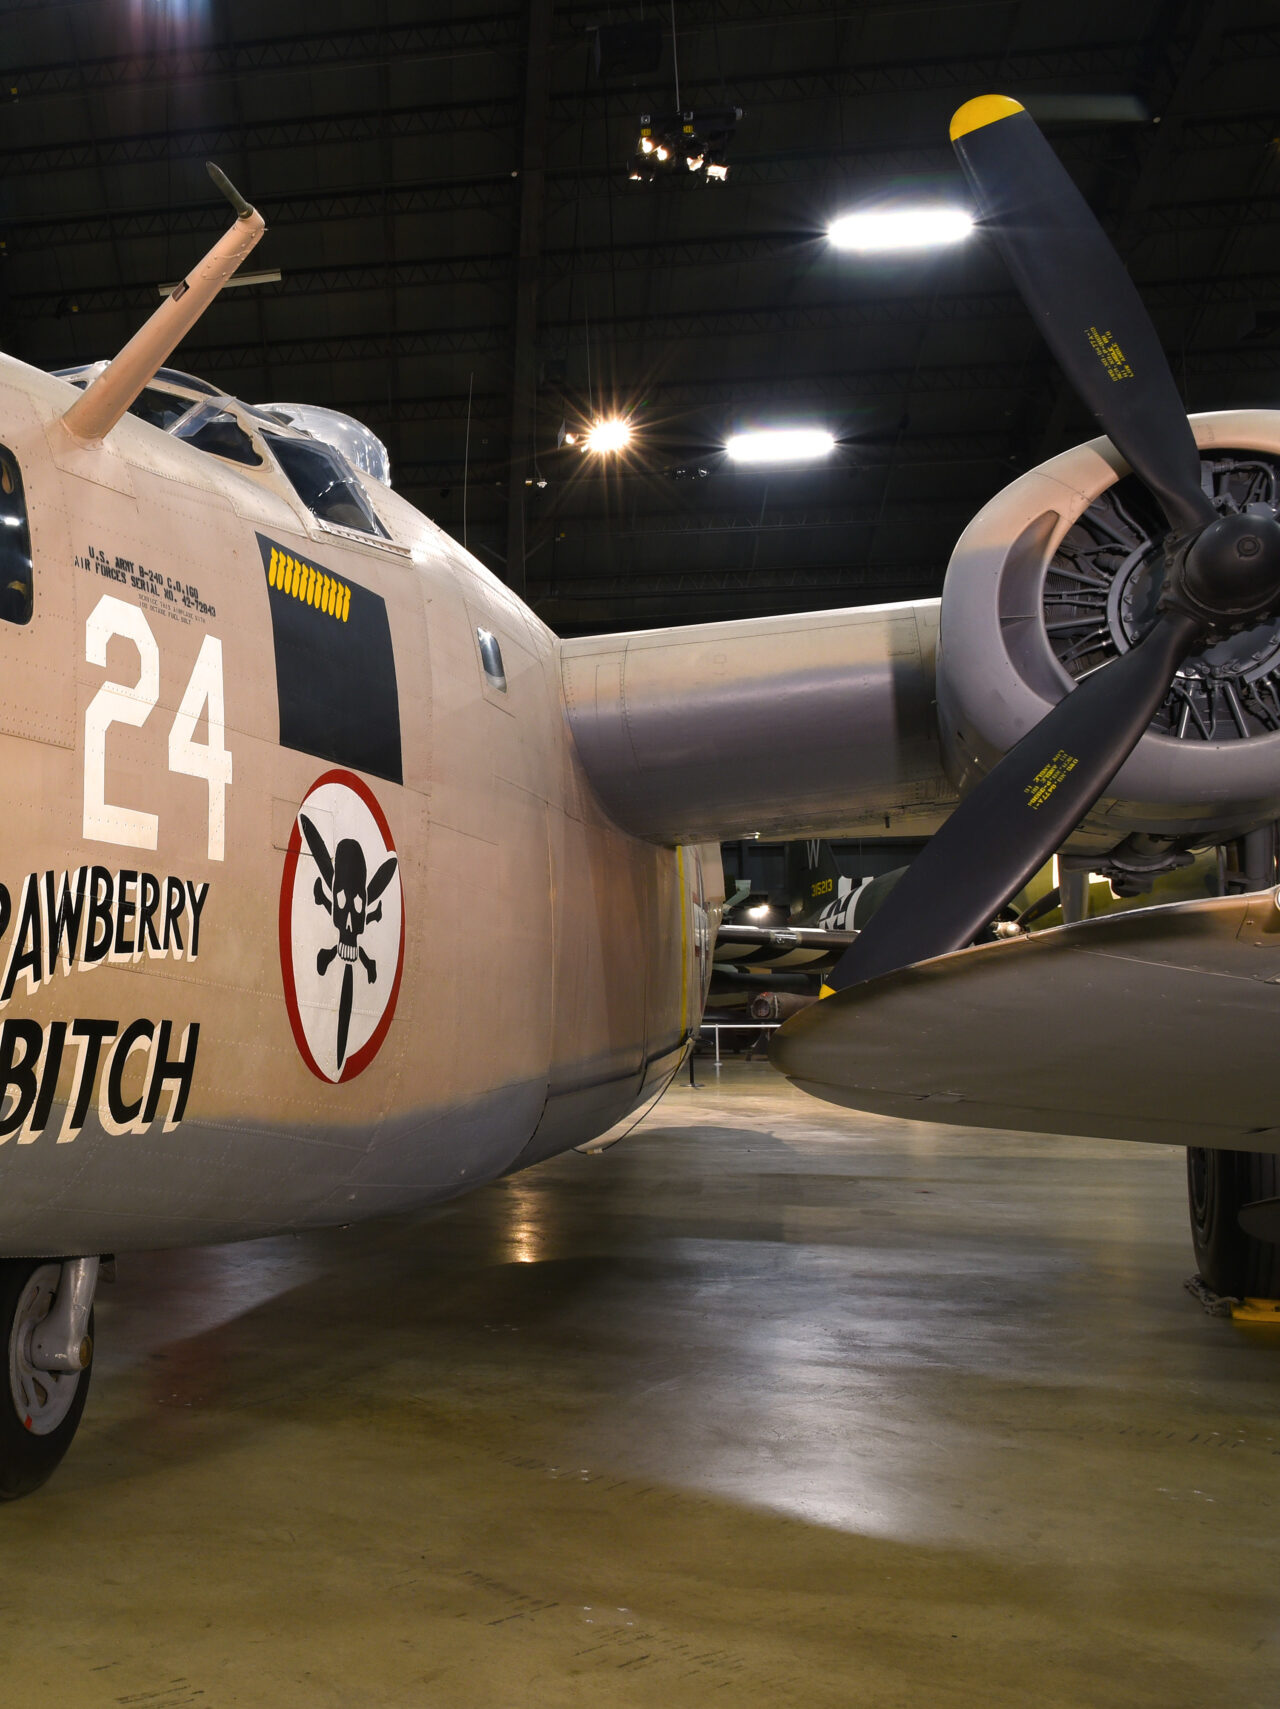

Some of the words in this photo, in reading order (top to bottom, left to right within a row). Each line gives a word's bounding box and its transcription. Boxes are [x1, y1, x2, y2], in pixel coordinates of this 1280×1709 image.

[74, 555, 91, 571] AIR
[95, 562, 127, 584] FORCES
[130, 575, 160, 597] SERIAL
[163, 588, 177, 603] NO.
[88, 545, 109, 565] U.S.
[115, 556, 135, 574] ARMY
[139, 565, 163, 586] B-24D
[83, 594, 232, 862] 24
[811, 878, 833, 897] 315213
